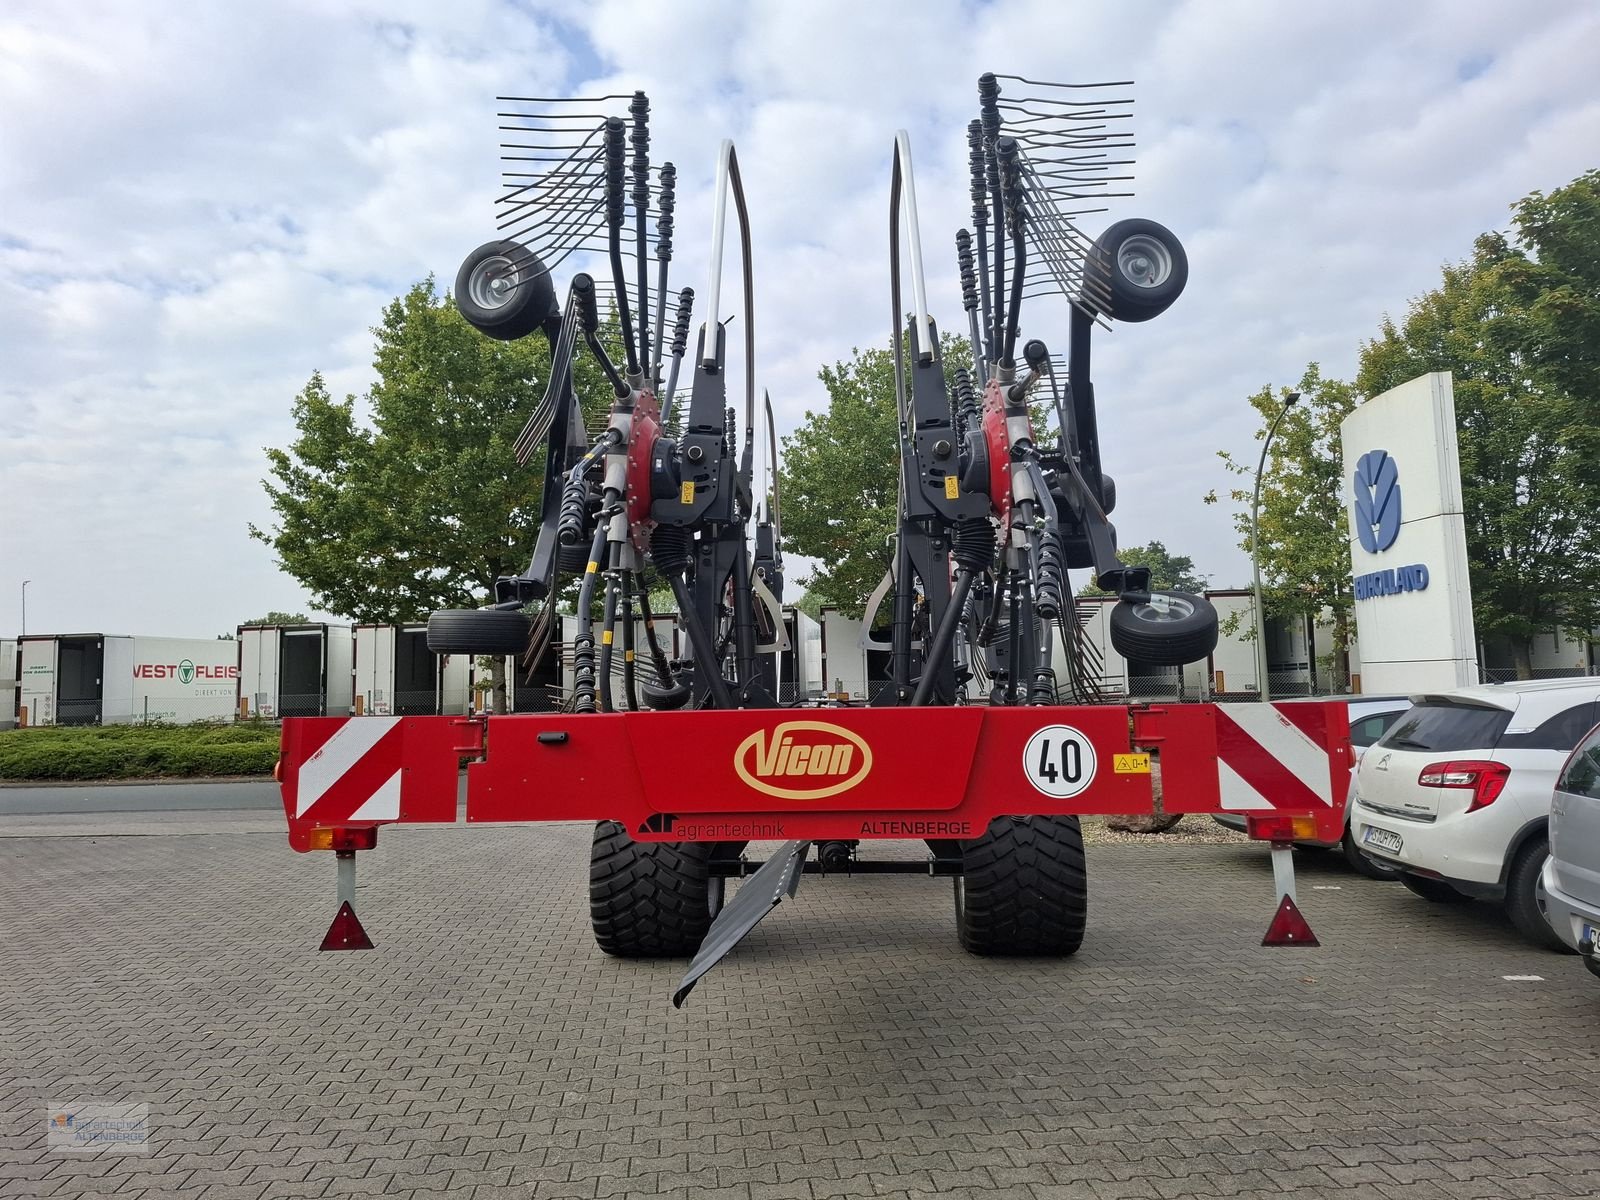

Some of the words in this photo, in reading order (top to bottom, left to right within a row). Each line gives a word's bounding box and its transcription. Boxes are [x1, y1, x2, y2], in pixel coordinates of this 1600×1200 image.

[756, 728, 854, 776] Vicon
[1039, 739, 1082, 783] 40
[677, 820, 786, 841] agrartechnik
[860, 821, 971, 835] ALTENBERGE
